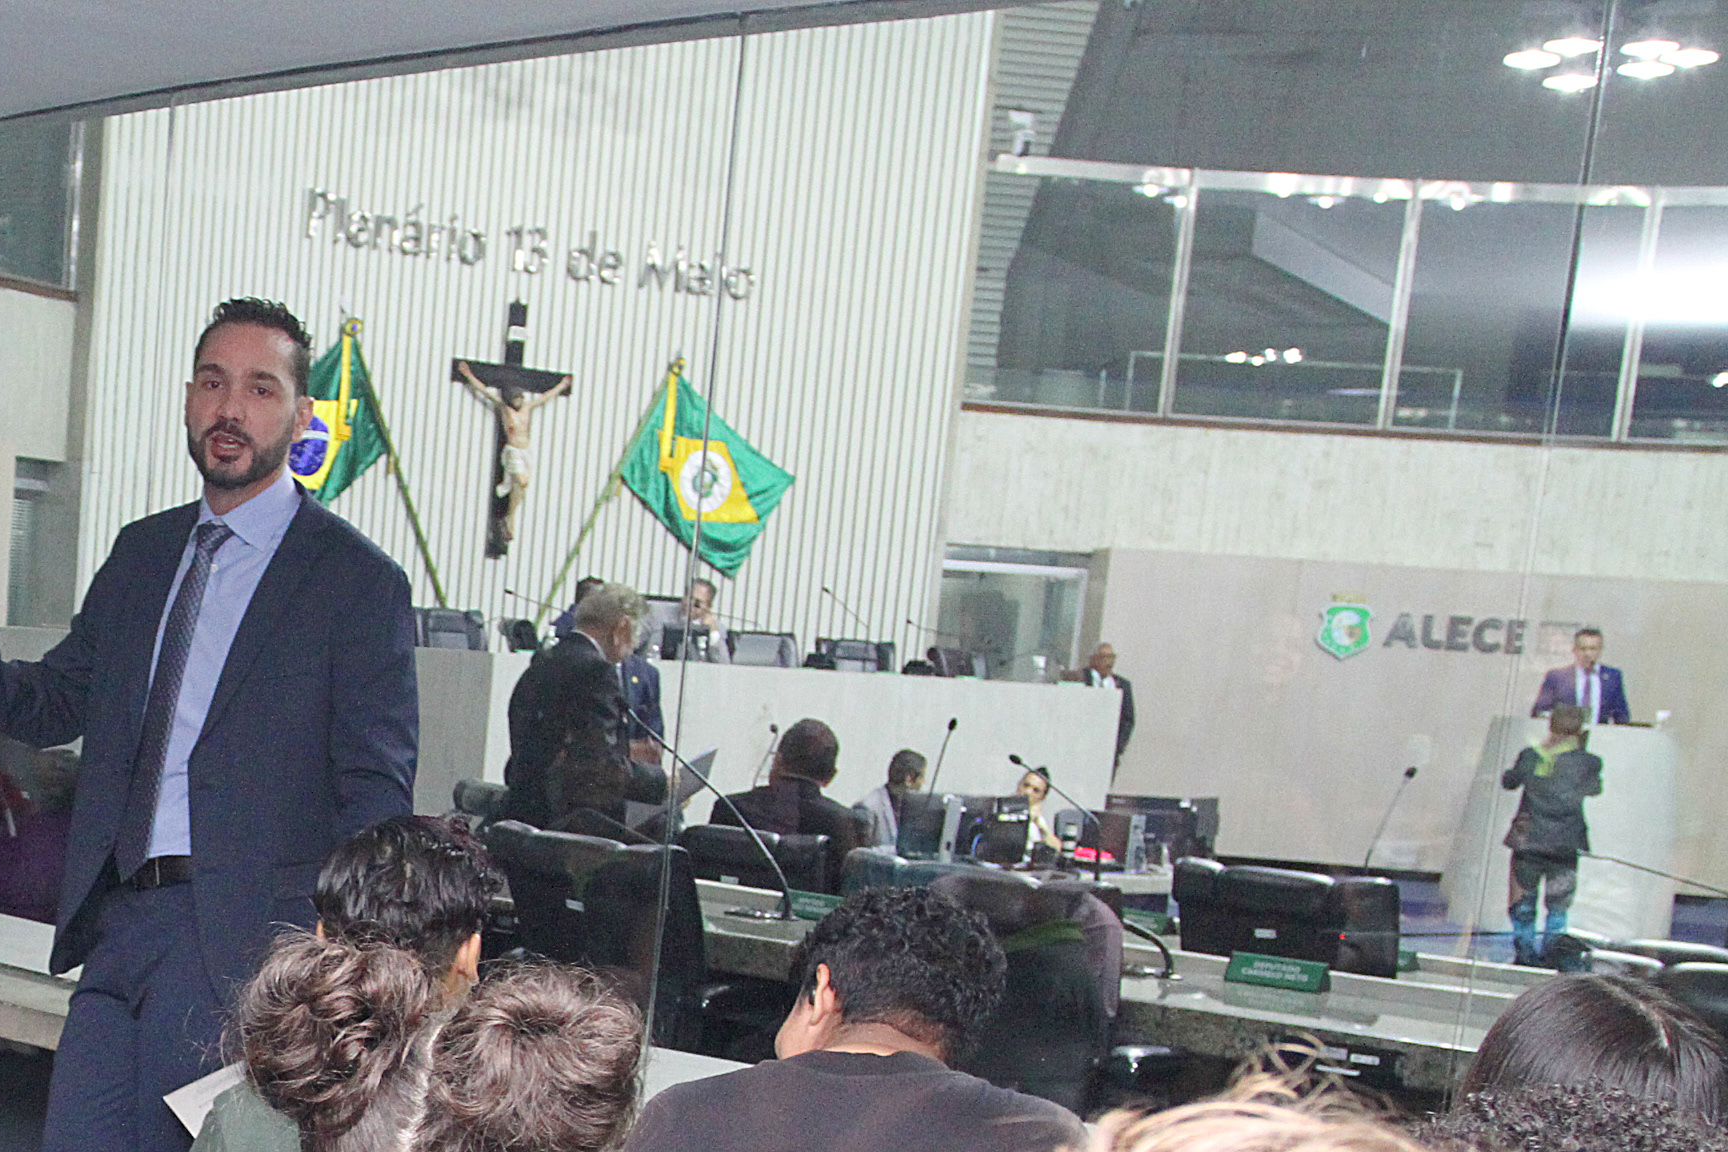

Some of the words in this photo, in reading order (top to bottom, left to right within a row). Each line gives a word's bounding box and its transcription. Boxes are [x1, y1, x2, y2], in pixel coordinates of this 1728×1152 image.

[303, 187, 486, 266] Plenário
[506, 225, 550, 275] 13
[567, 229, 623, 285] de
[638, 240, 756, 301] Maio
[1382, 612, 1528, 656] ALECE
